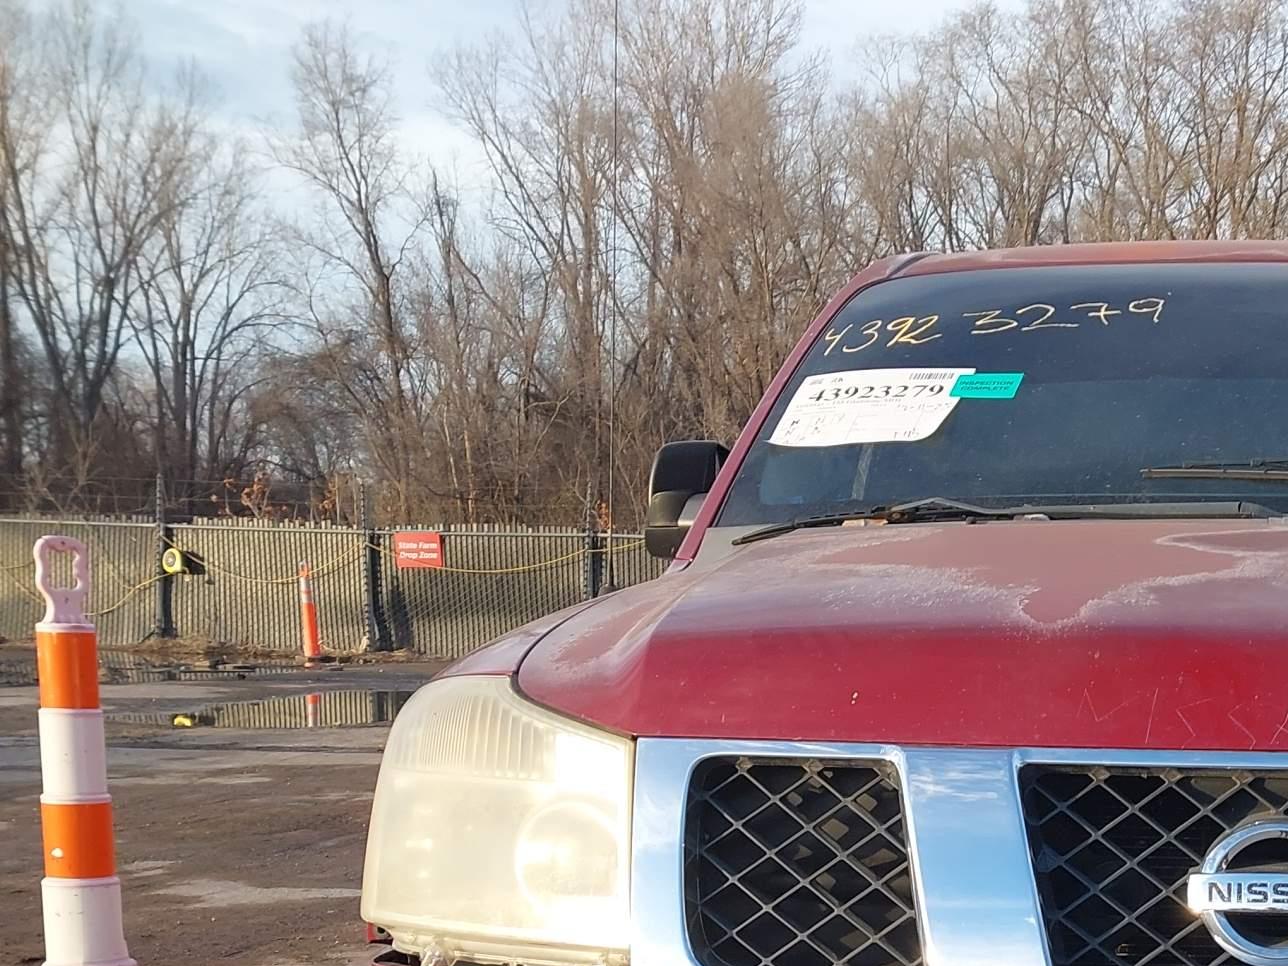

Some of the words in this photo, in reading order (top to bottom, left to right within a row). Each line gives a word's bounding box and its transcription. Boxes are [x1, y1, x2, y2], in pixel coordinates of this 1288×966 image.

[823, 314, 943, 356] 4392
[961, 297, 1166, 335] 3279
[808, 383, 944, 402] 43923279
[400, 551, 417, 560] Drop
[419, 551, 437, 559] Zone
